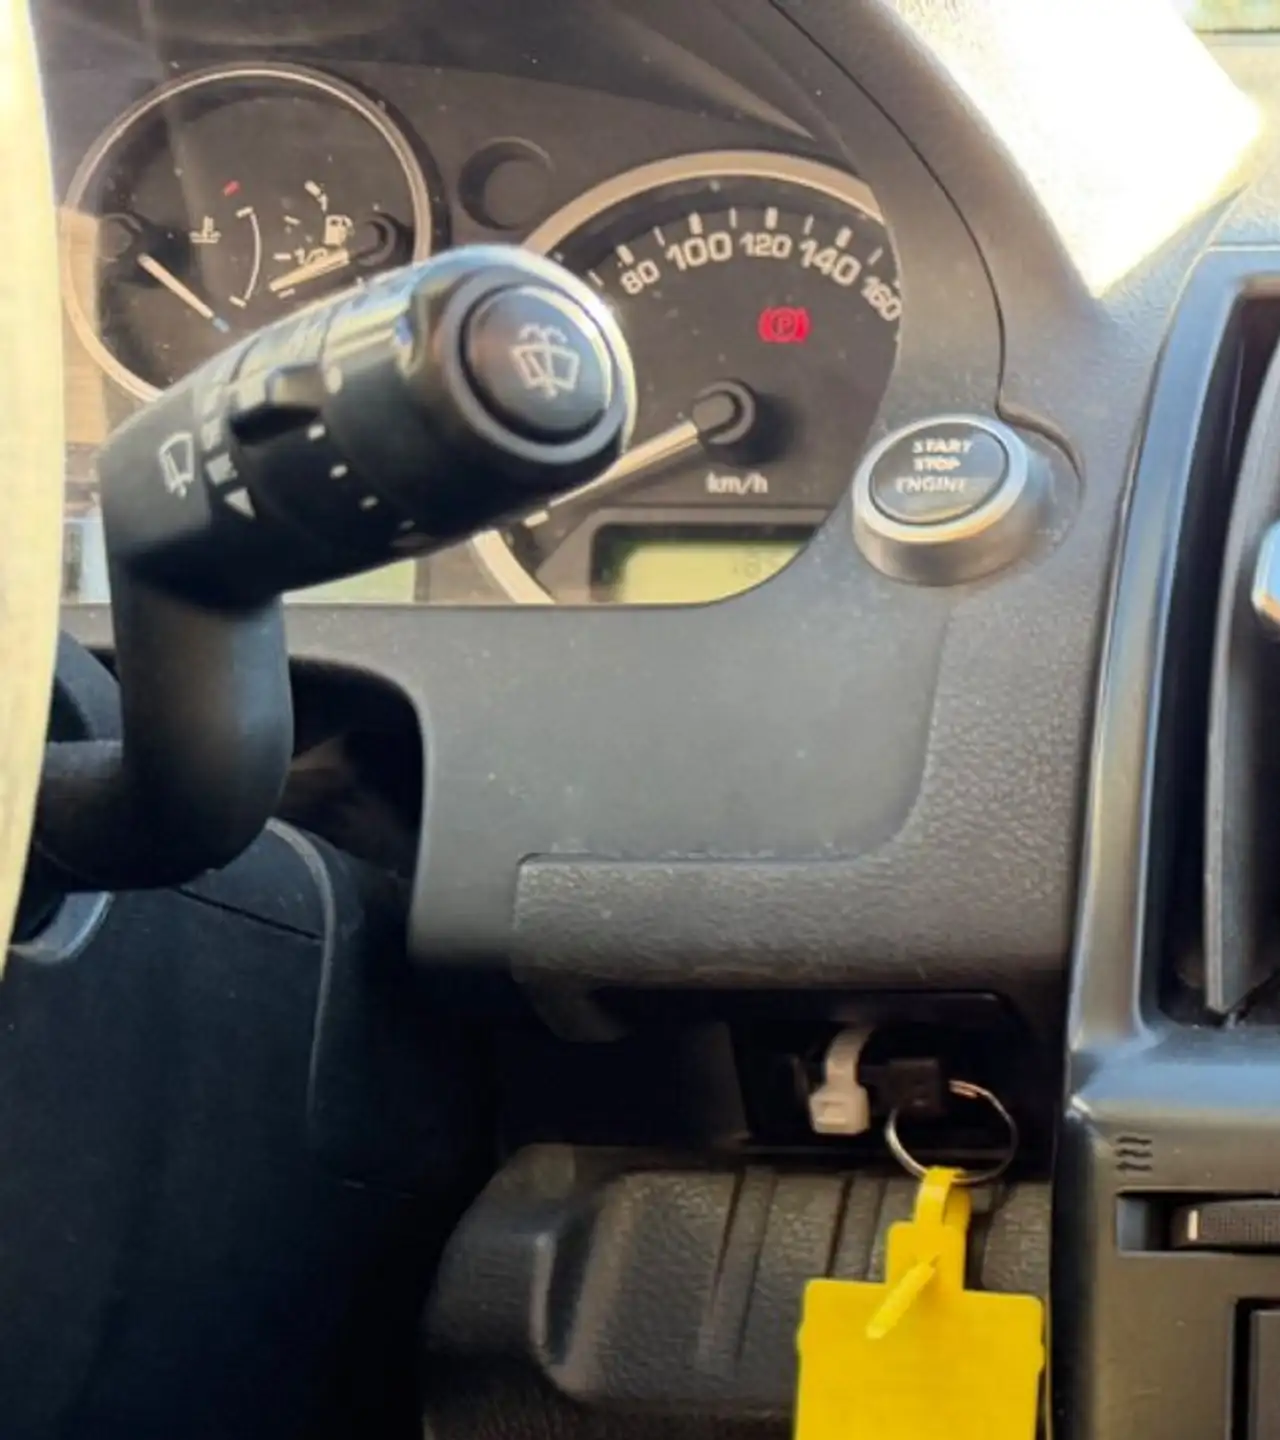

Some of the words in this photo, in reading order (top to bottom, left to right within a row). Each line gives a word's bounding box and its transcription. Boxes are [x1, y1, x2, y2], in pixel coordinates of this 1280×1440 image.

[665, 231, 733, 272] 100
[740, 232, 792, 258] 120
[800, 239, 861, 286] 140
[620, 260, 661, 295] 80
[861, 274, 902, 322] 160
[912, 437, 974, 454] START
[912, 456, 962, 472] STOP
[705, 471, 769, 495] km/h
[894, 474, 969, 495] ENGINE
